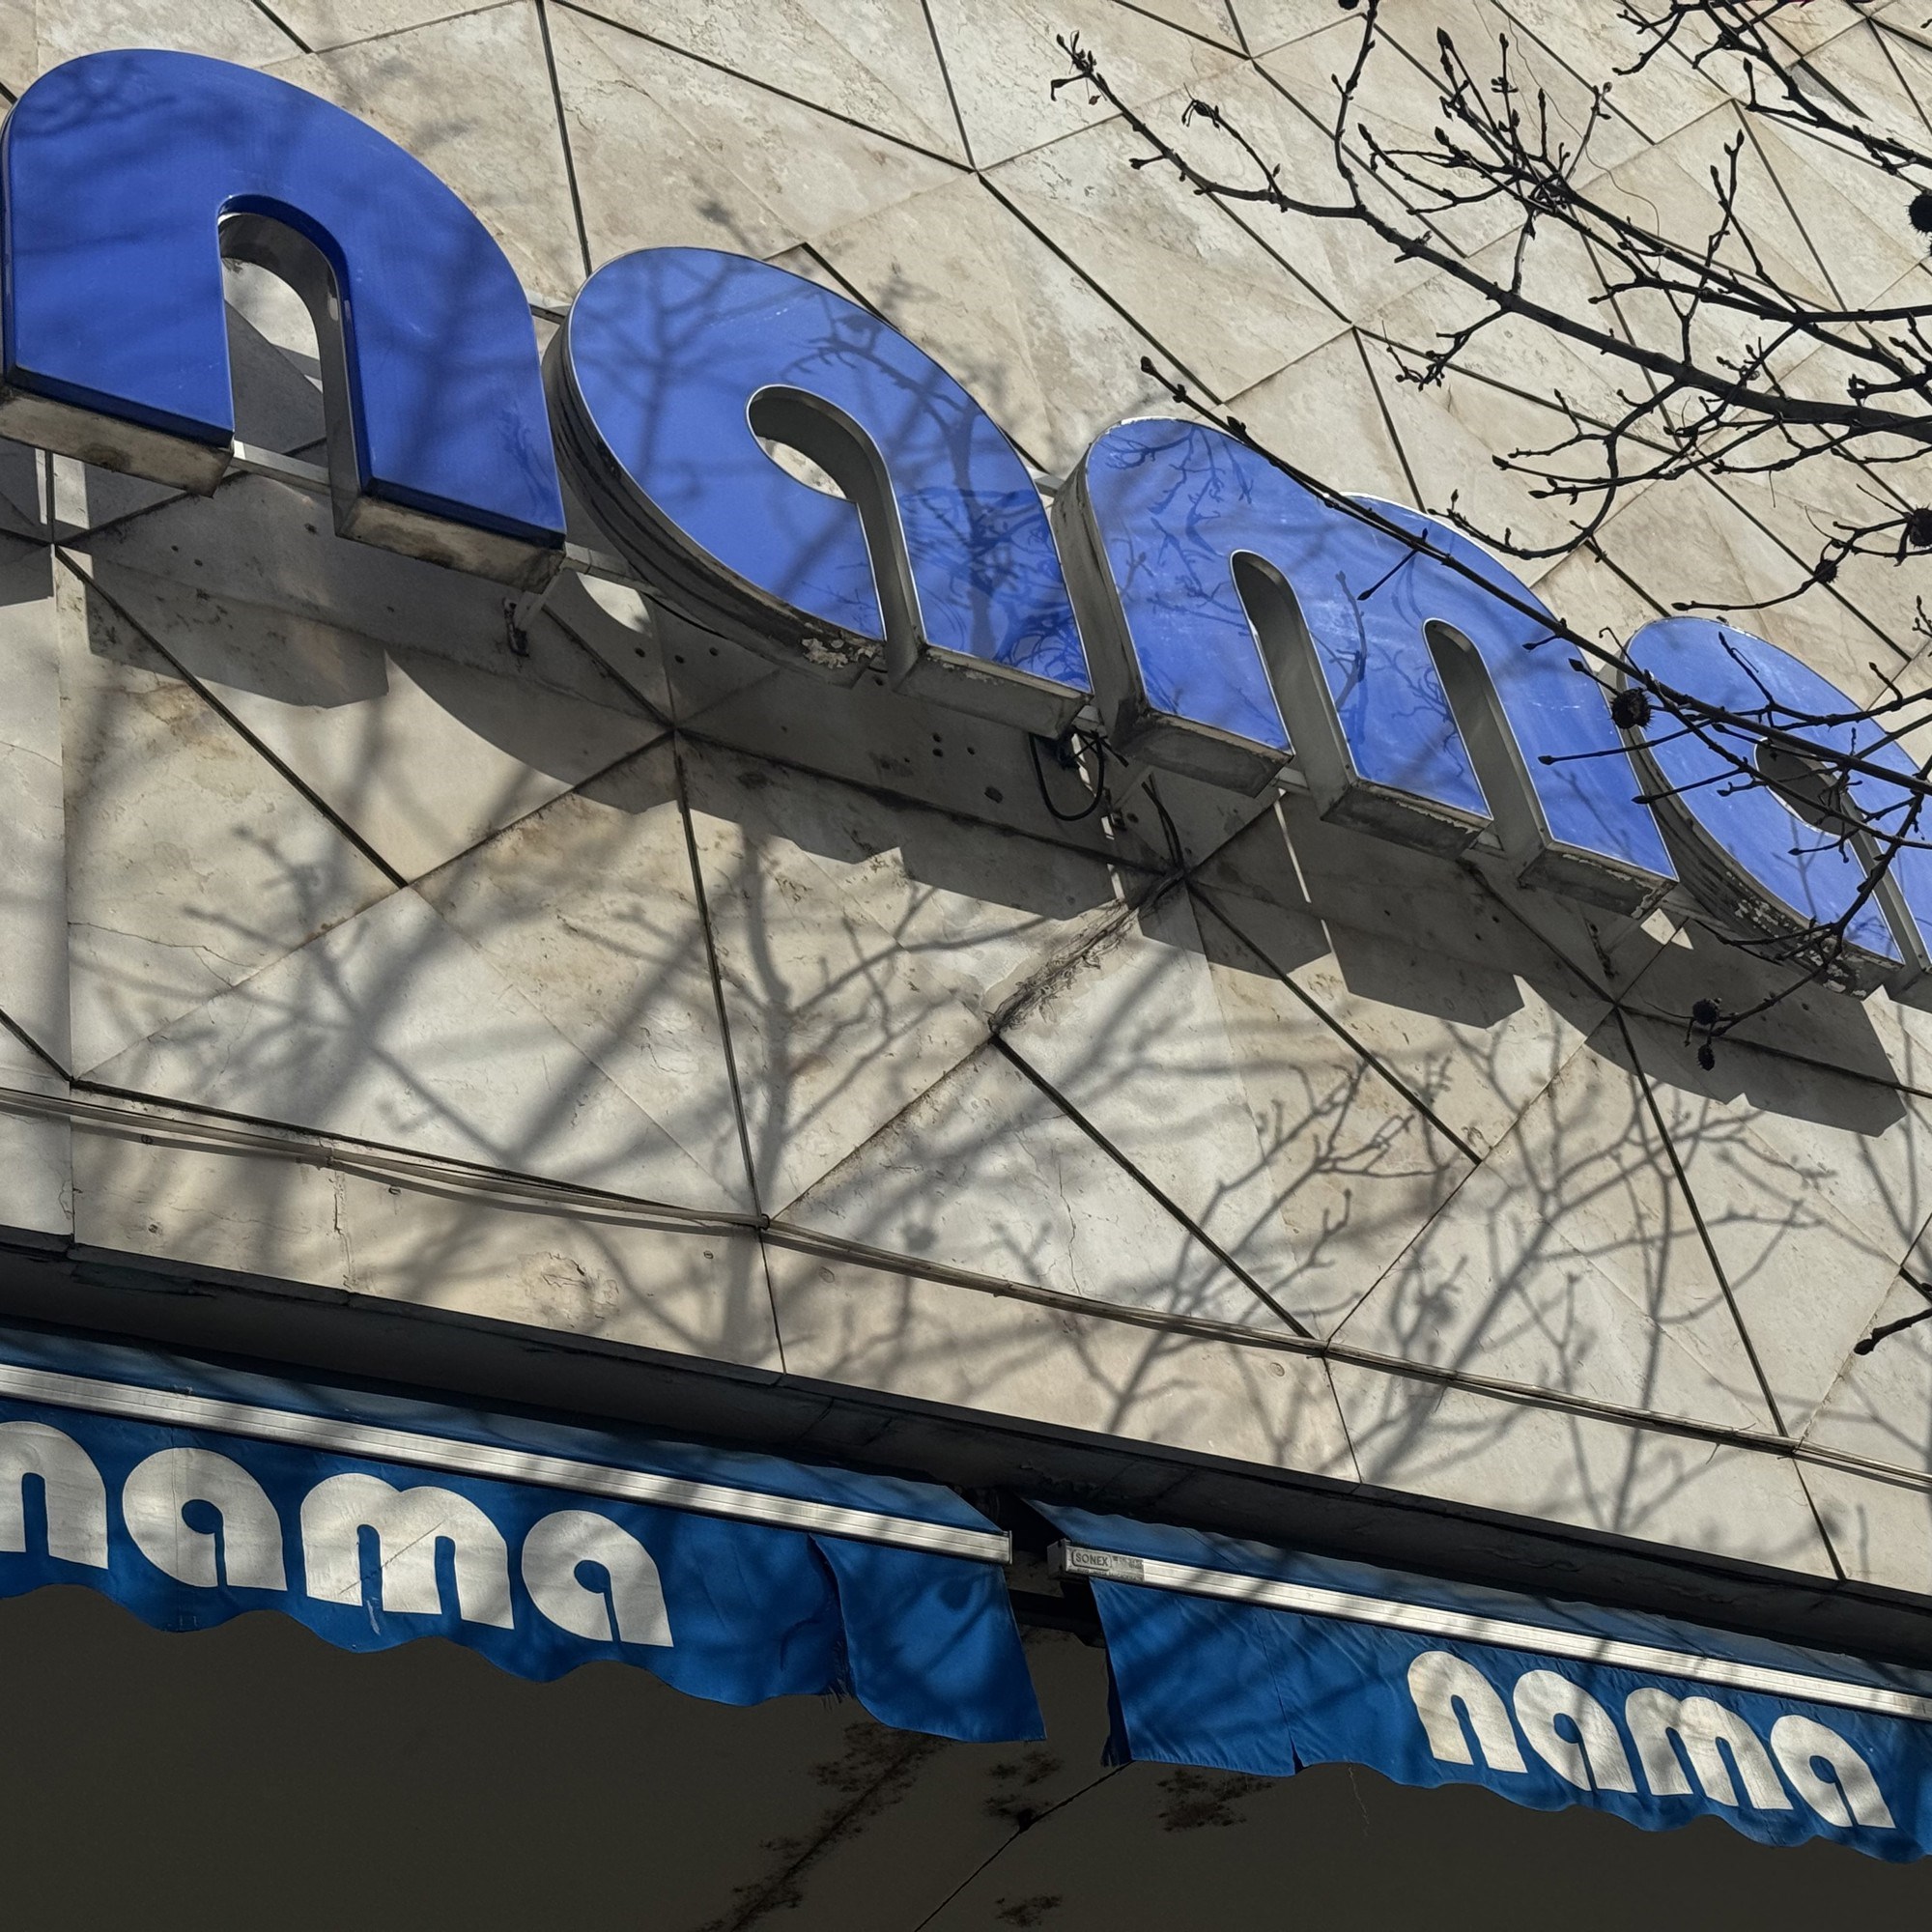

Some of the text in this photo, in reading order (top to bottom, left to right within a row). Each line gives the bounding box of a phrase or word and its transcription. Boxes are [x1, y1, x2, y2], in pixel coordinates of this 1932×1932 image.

[4, 48, 1932, 964] nama
[0, 1421, 673, 1647] nama
[1074, 1552, 1109, 1567] SONEX
[1406, 1650, 1896, 1829] nama
